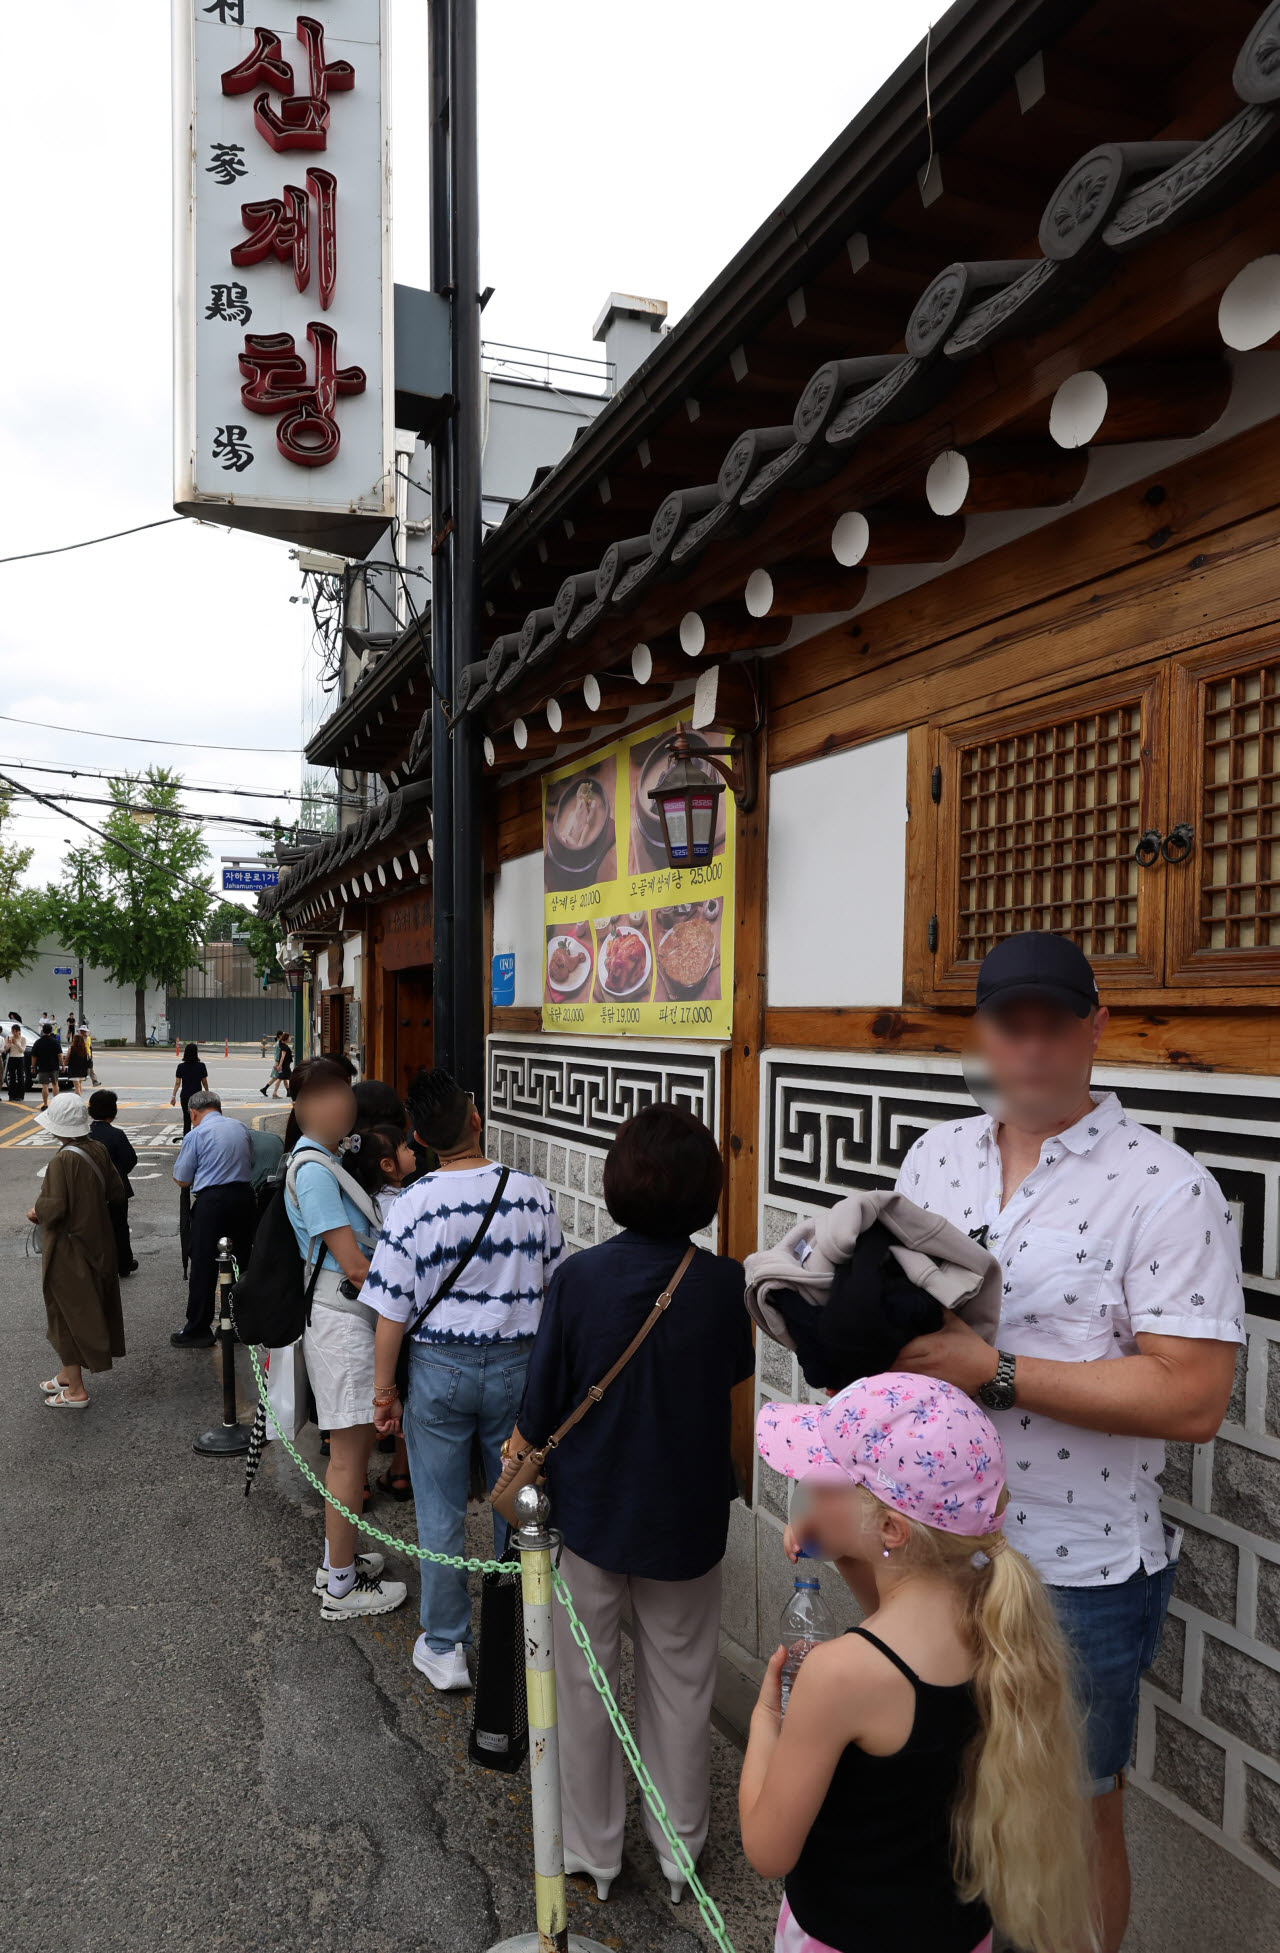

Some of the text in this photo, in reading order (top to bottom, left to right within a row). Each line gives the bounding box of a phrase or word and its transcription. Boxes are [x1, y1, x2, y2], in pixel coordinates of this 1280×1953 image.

[221, 15, 366, 466] 삼계탕
[630, 862, 722, 896] 오골계삼계탕 25,000
[552, 894, 577, 911] 삼계탕
[563, 1008, 584, 1023] 20,000
[600, 1006, 640, 1024] 통닭 19,000
[659, 1006, 712, 1024] 파전 17,000
